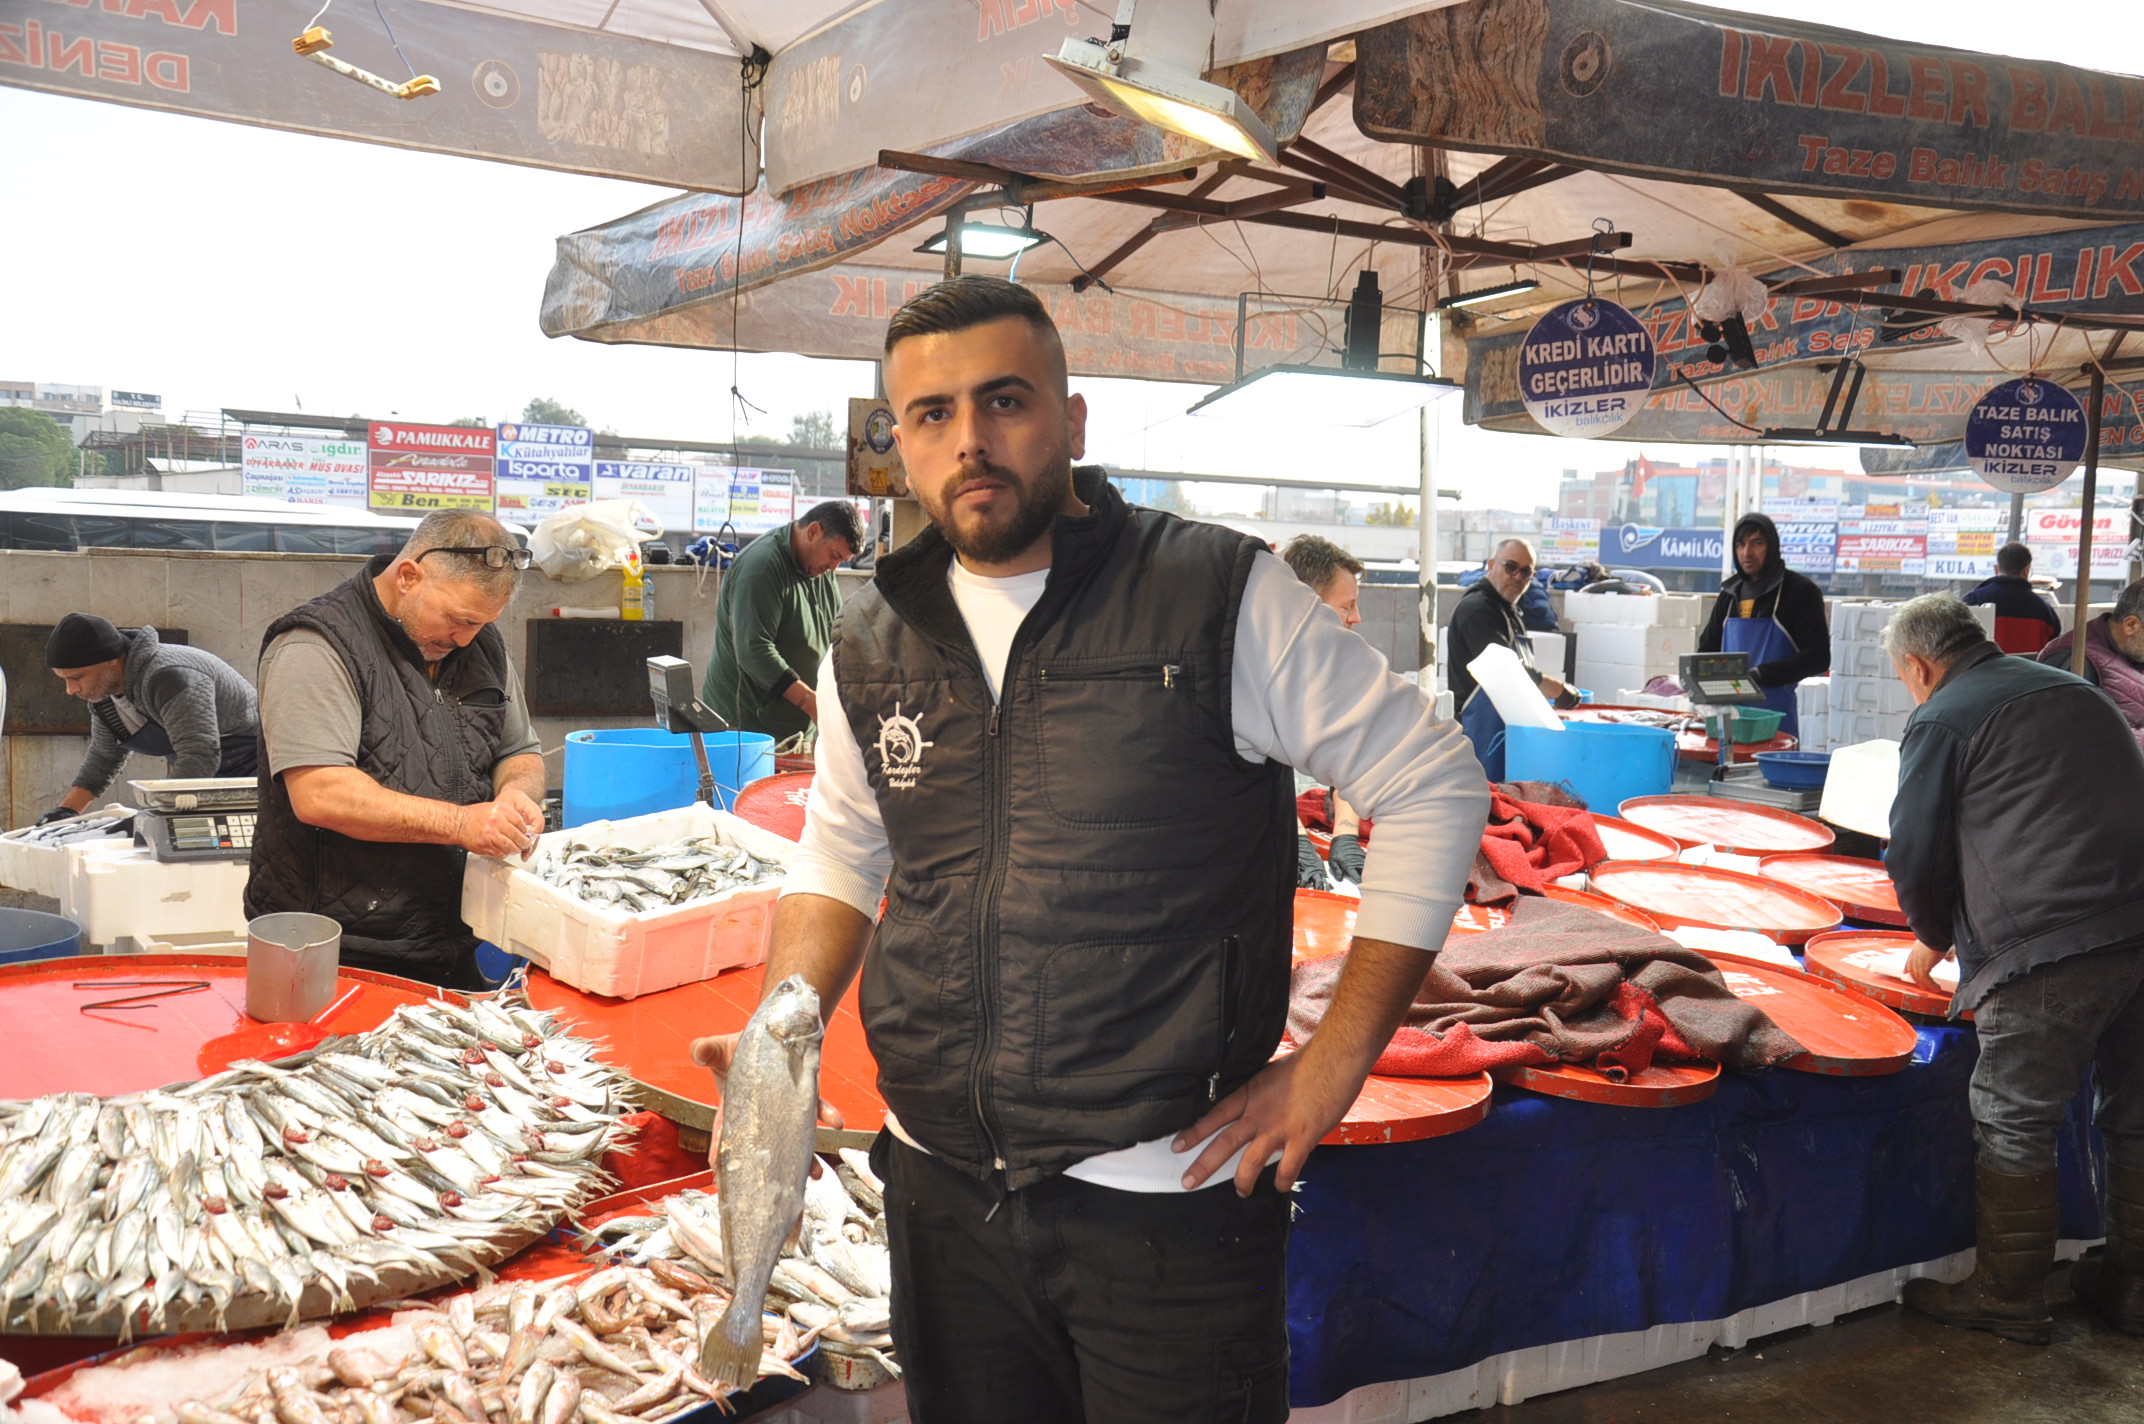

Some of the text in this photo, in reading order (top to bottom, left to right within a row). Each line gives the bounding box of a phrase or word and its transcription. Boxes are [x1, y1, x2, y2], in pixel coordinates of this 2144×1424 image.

[1798, 136, 1898, 180] Taze
[1525, 331, 1647, 366] KREDİ KARTI
[1530, 358, 1644, 396] GEÇERLİDİR
[1544, 397, 1626, 419] İKİZLER
[1976, 405, 2080, 423] TAZE BALIK
[395, 430, 491, 449] PAMUKKALE
[518, 425, 589, 446] METRO
[2000, 425, 2051, 444] SATIŞ
[257, 440, 304, 452] ARAS
[1984, 443, 2064, 461] NOKTASI
[508, 460, 580, 479] Isparta
[619, 463, 690, 481] varan
[1983, 459, 2058, 476] İKİZLER
[402, 470, 477, 487] SARIKIZ
[402, 493, 440, 508] Ben
[2039, 514, 2113, 530] Güvn
[1935, 560, 1976, 574] KULA
